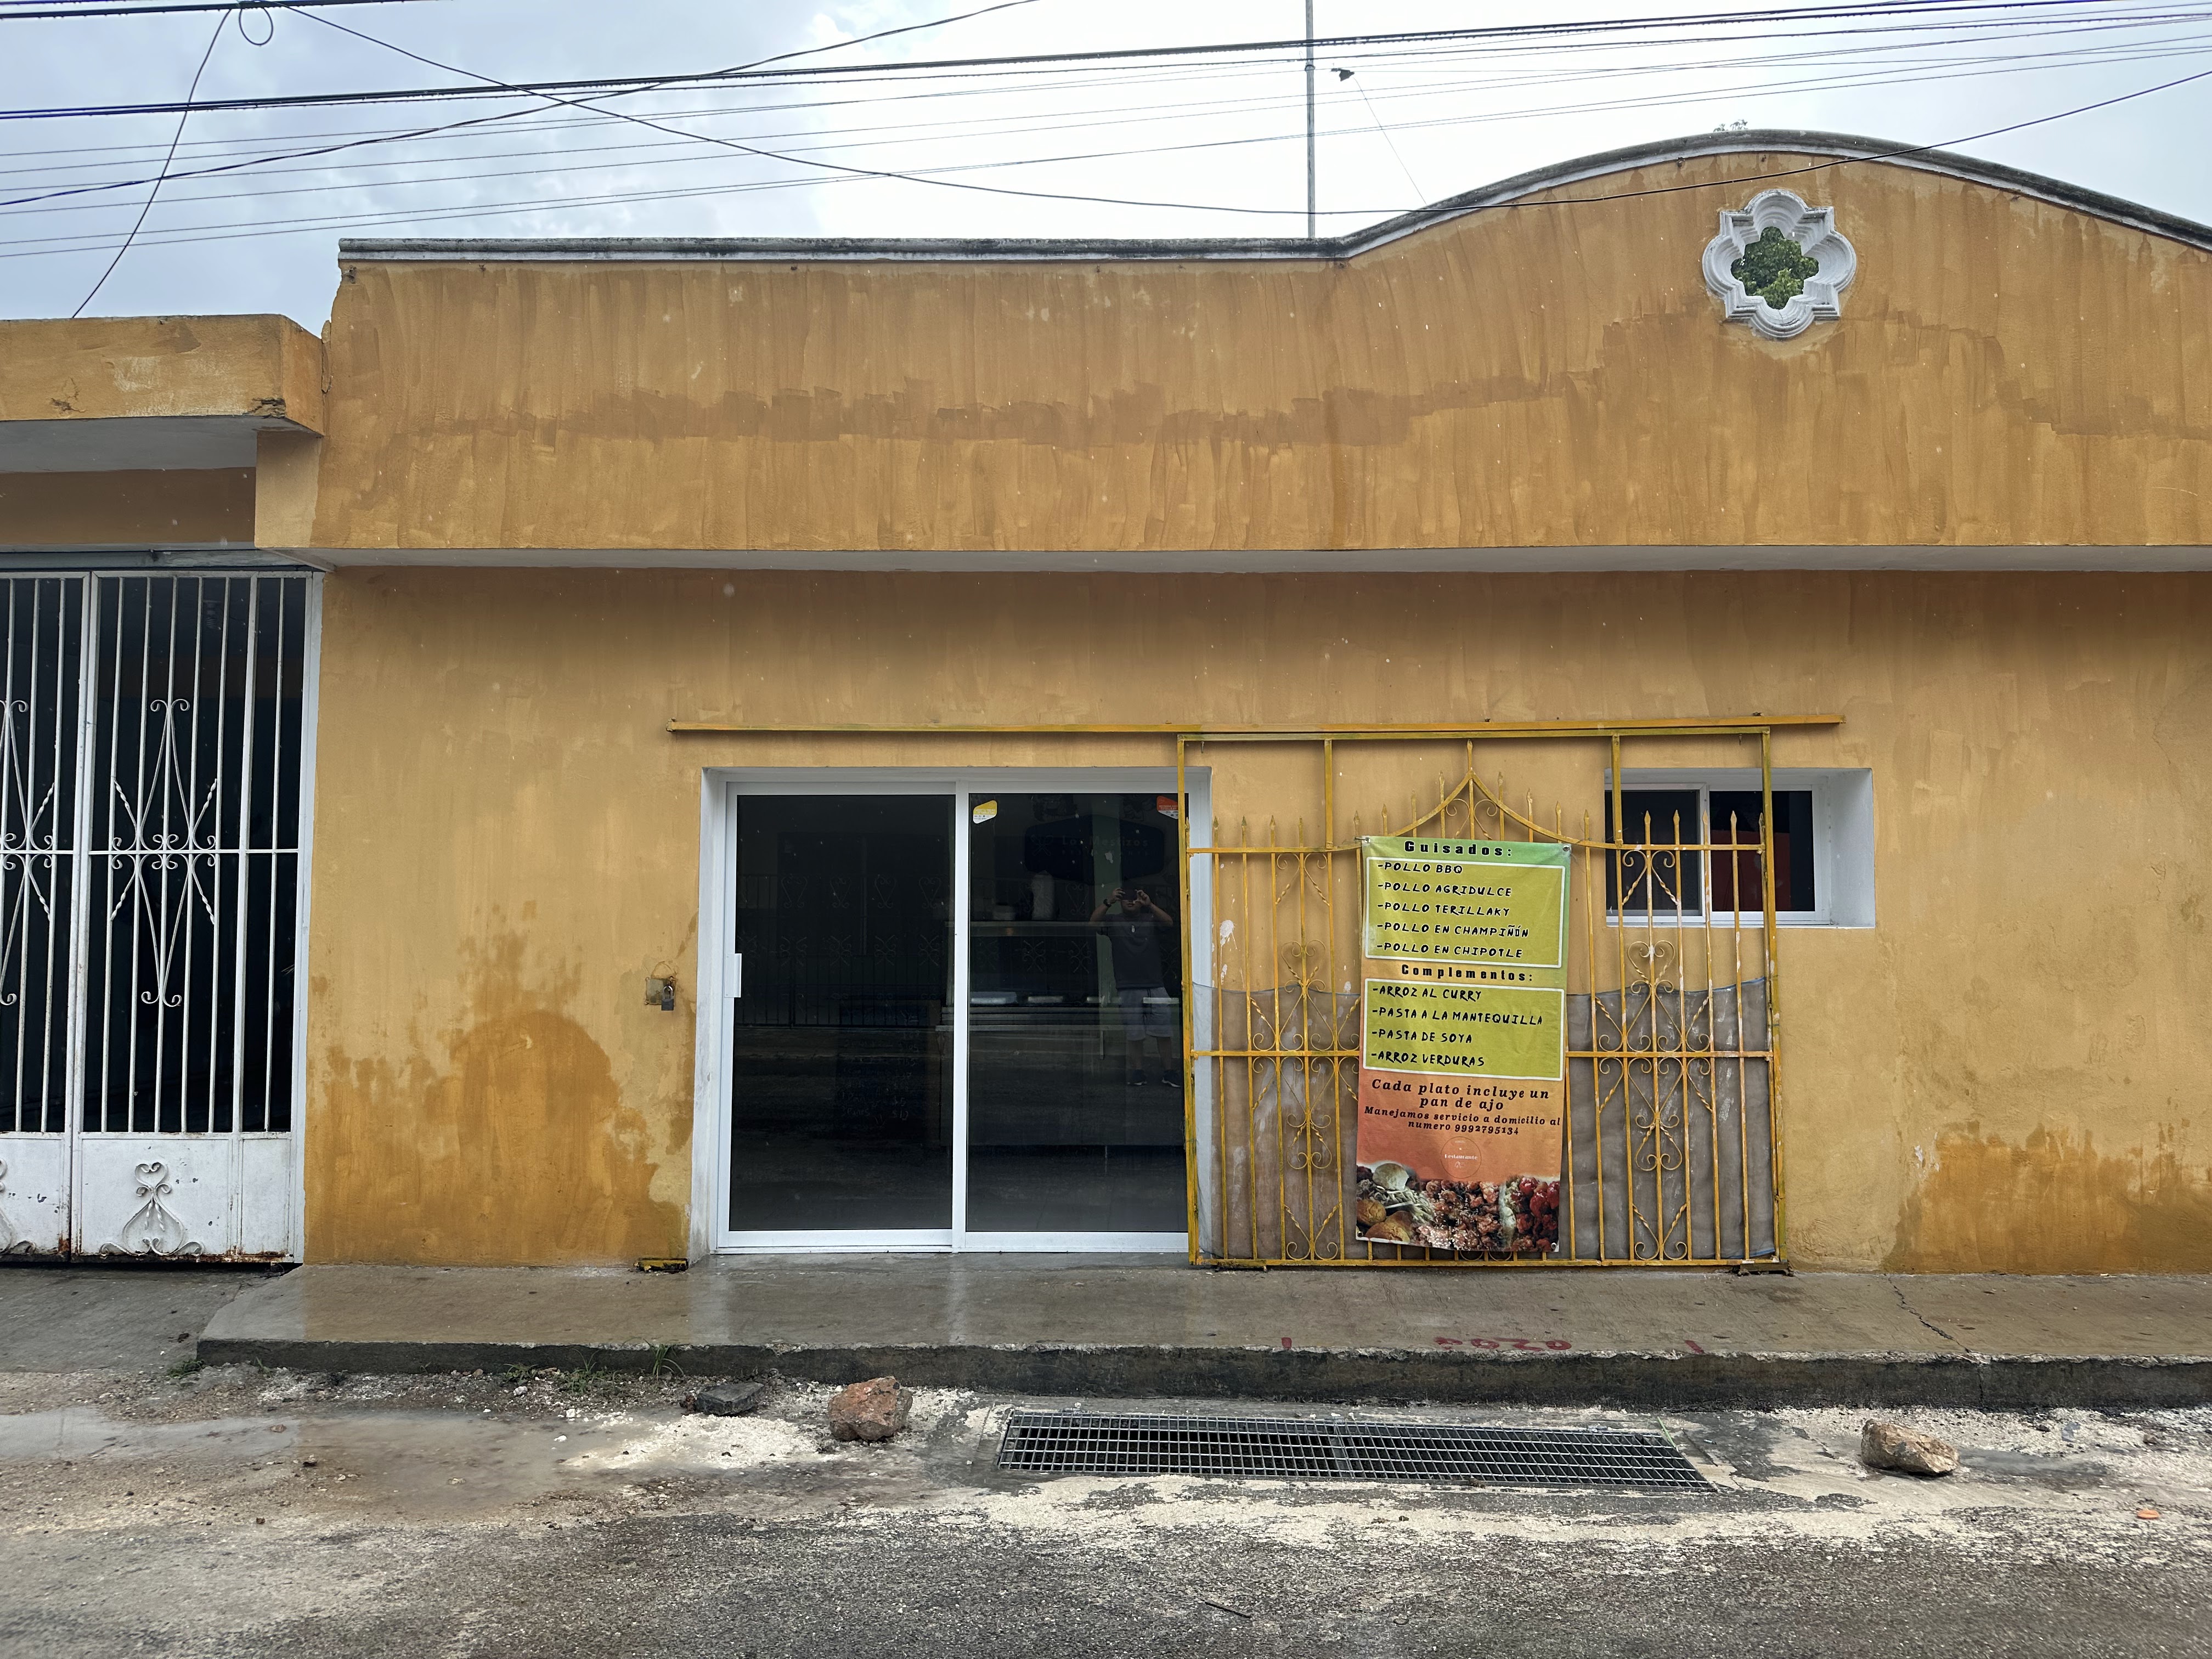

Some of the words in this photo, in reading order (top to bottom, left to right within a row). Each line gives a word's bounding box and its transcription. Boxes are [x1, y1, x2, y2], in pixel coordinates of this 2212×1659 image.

[1062, 835, 1084, 845] Lo
[1404, 840, 1512, 856] Guisados:
[1378, 862, 1430, 872] -POLLO
[1436, 866, 1463, 874] BBQ
[1378, 882, 1430, 893] -POLLO
[1435, 885, 1512, 897] AGRIDULCE
[1377, 902, 1430, 912] -POLLO
[1435, 905, 1510, 917] TERILLAKY
[1377, 922, 1429, 932] -POLLO
[1435, 925, 1449, 933] EN
[1454, 924, 1528, 938] CHAMPIÑÓN
[1376, 943, 1429, 953] -POLLO
[1435, 945, 1449, 954] EN
[1454, 946, 1522, 958] CHIPOTLE
[1402, 964, 1533, 981] Complementos:
[1373, 986, 1418, 998] -ARROZ
[1422, 989, 1437, 998] AL
[1443, 989, 1481, 1002] CURRY
[1372, 1008, 1417, 1019] -PASTA
[1421, 1010, 1427, 1019] A
[1432, 1011, 1447, 1020] LA
[1453, 1011, 1543, 1025] MANTEQUILLA
[1372, 1030, 1417, 1040] -PASTA
[1421, 1032, 1435, 1042] DE
[1441, 1033, 1472, 1043] SOYA
[1371, 1051, 1418, 1063] -ARROZ
[1423, 1054, 1485, 1068] VERDURAS
[1372, 1079, 1412, 1092] Cada
[1418, 1082, 1459, 1096] plato
[1466, 1085, 1525, 1100] incluye
[1530, 1091, 1549, 1099] un
[1419, 1098, 1447, 1108] pan
[1455, 1098, 1472, 1108] de
[1479, 1101, 1504, 1111] ajo
[1364, 1106, 1429, 1119] Manejamos
[1434, 1113, 1479, 1122] servicio
[1494, 1115, 1545, 1125] domicilio
[1550, 1118, 1560, 1126] al
[1408, 1121, 1451, 1131] numero
[1454, 1124, 1519, 1135] 9992795134
